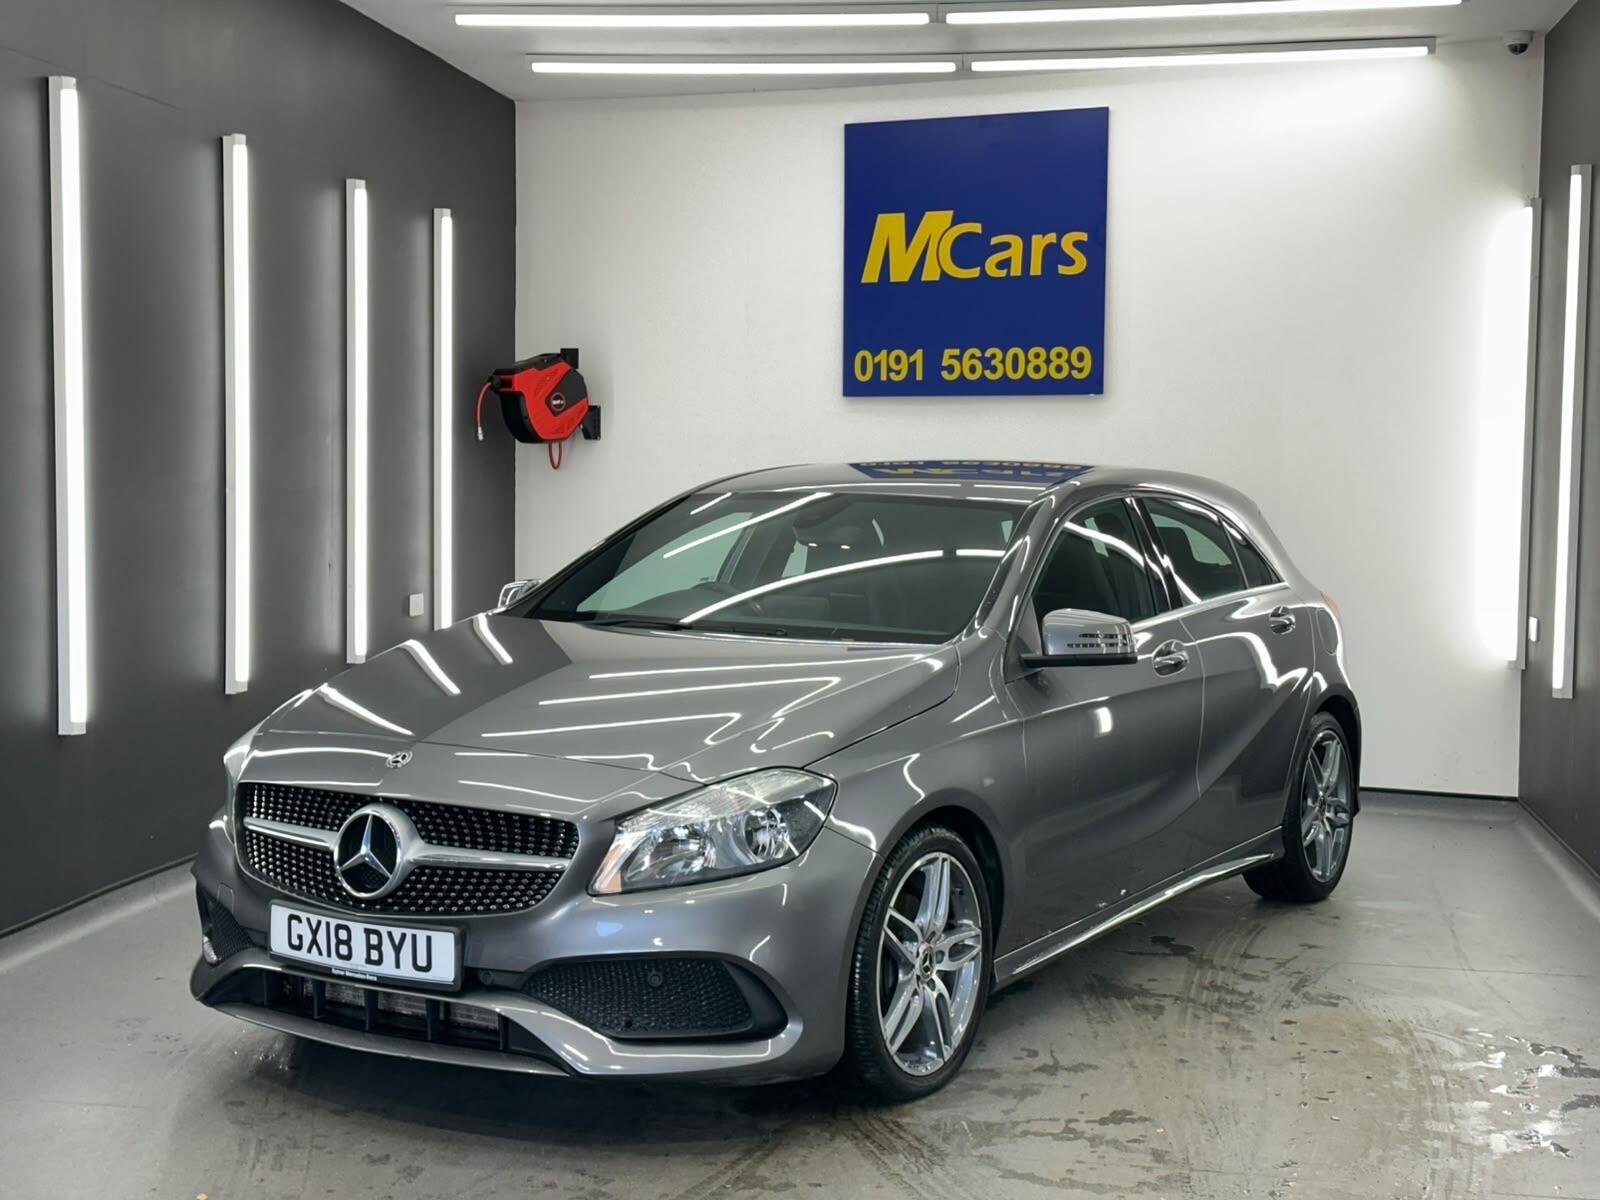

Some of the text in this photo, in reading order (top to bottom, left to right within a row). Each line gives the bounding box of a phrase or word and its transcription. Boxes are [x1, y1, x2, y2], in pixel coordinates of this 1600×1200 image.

[860, 210, 1088, 283] MCars
[854, 346, 1092, 382] 0191 5630889
[287, 913, 432, 973] GX18 BYU
